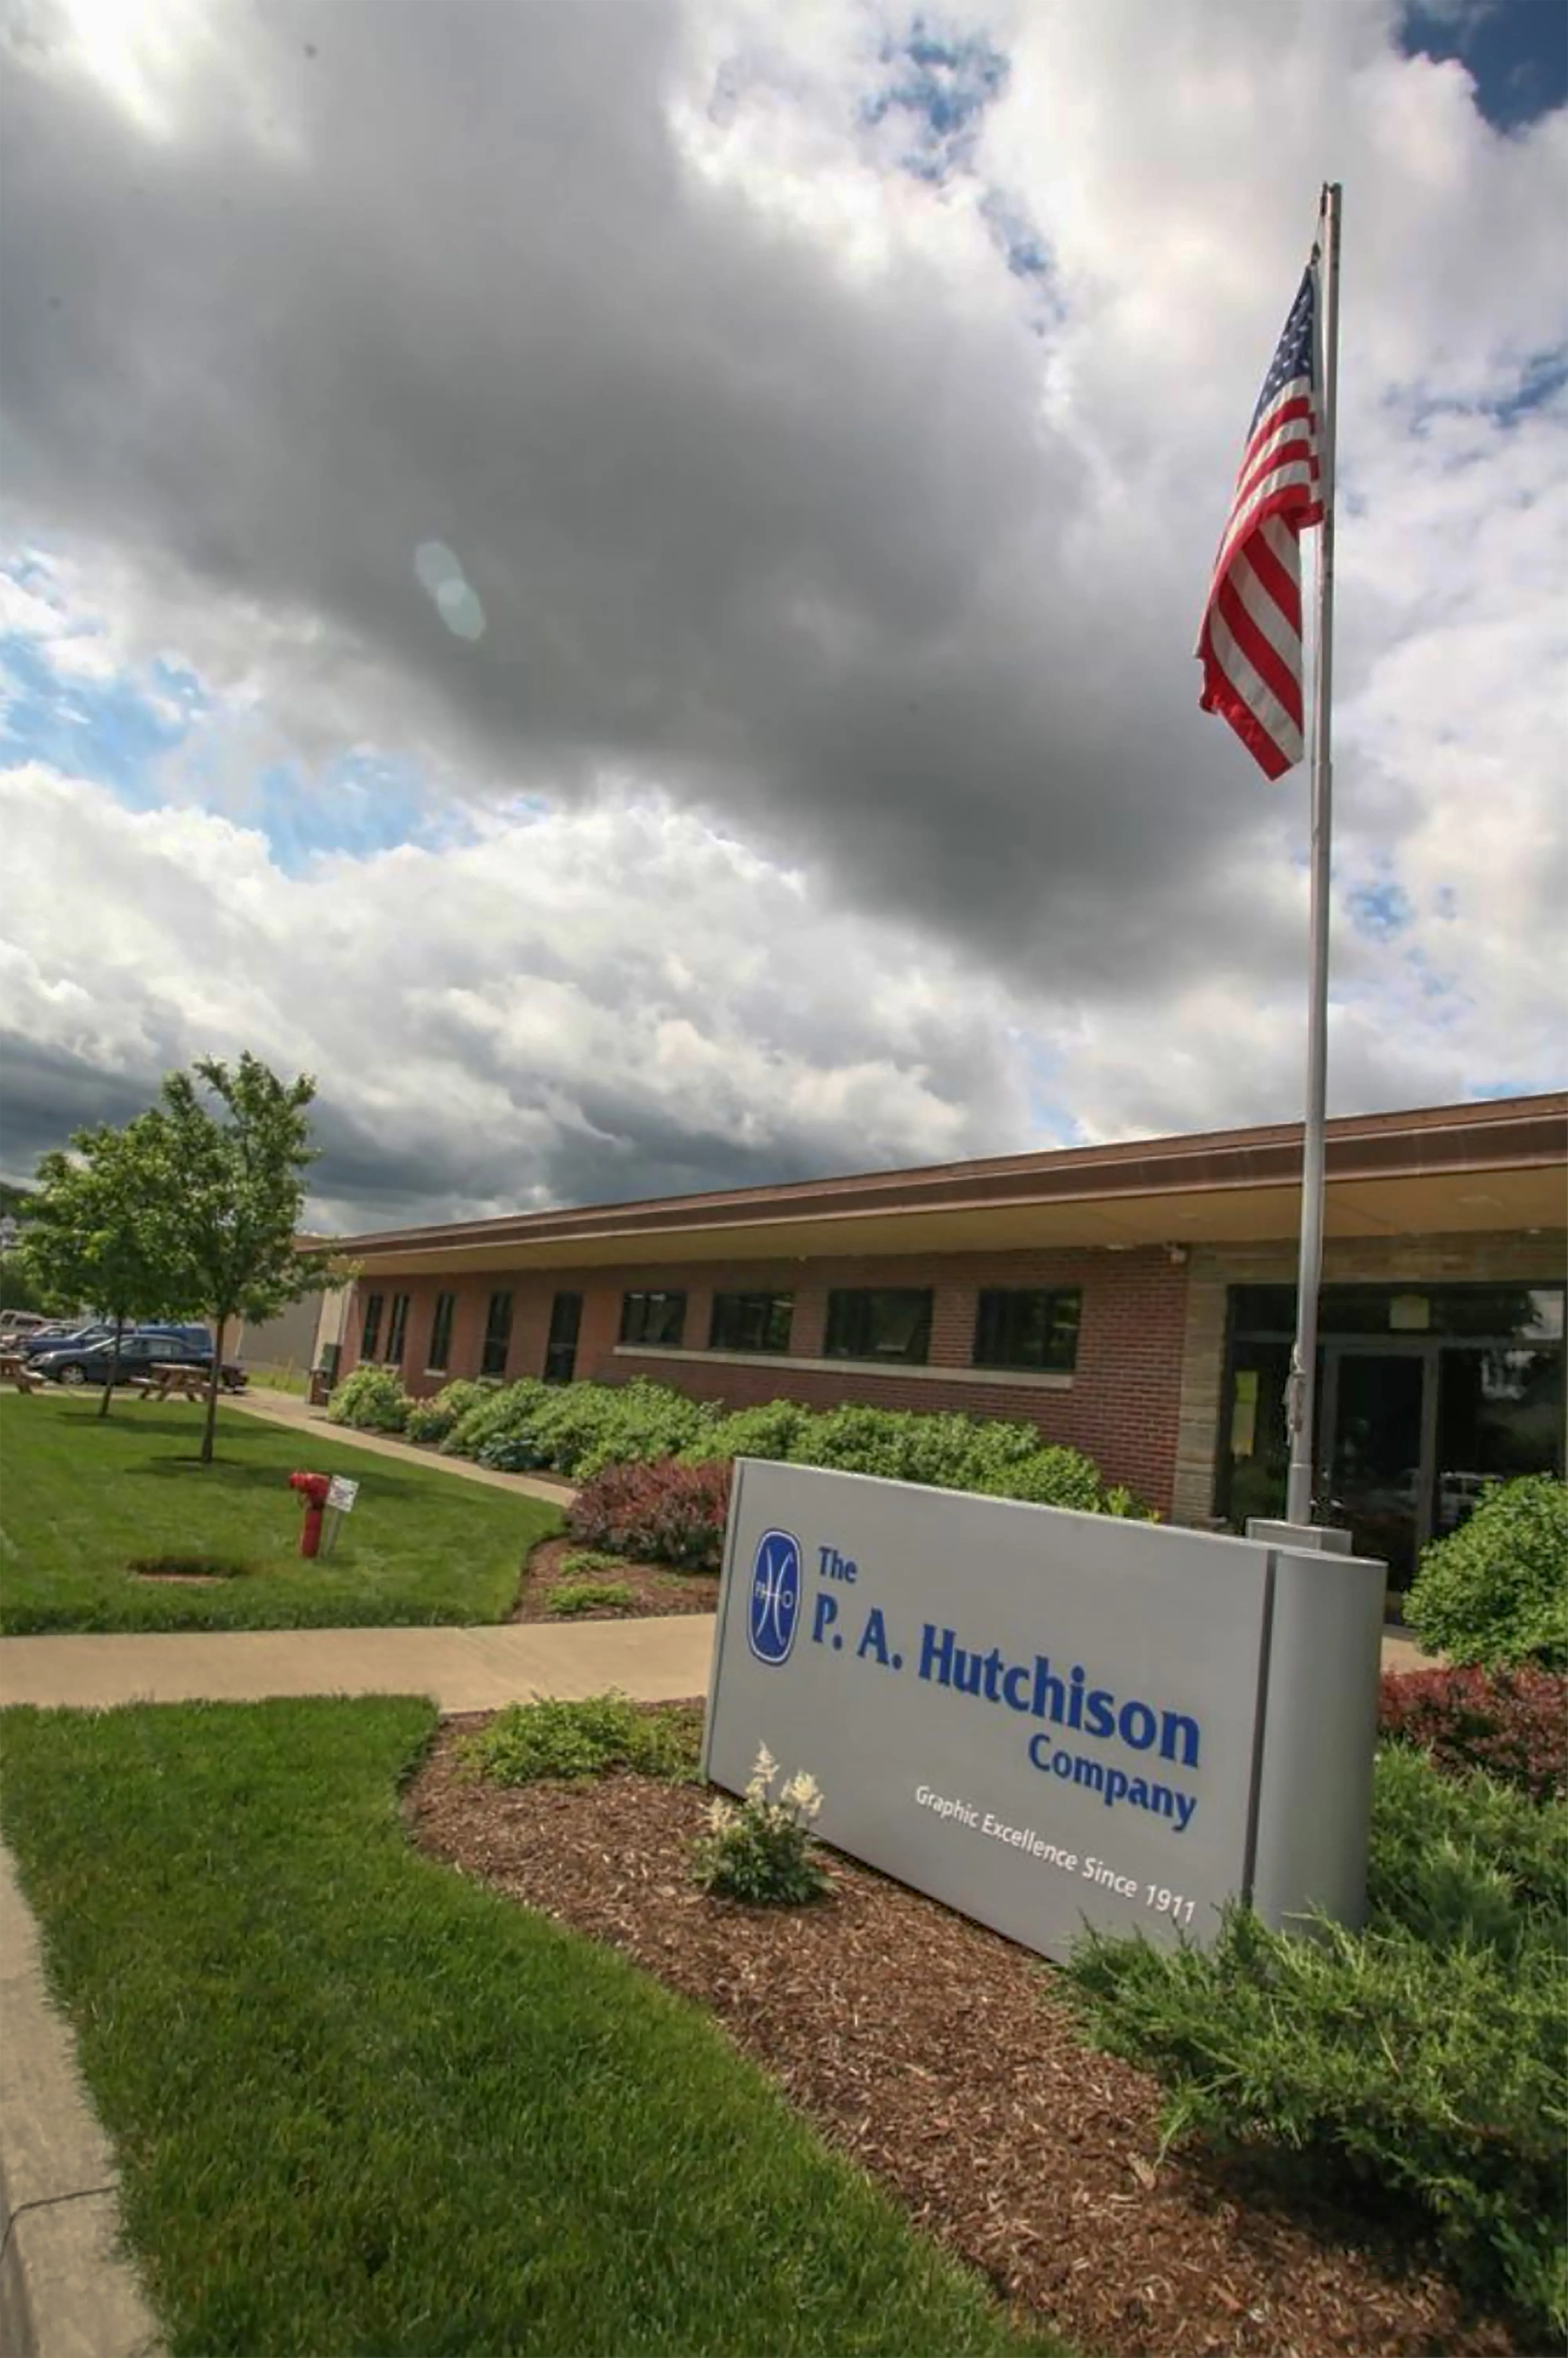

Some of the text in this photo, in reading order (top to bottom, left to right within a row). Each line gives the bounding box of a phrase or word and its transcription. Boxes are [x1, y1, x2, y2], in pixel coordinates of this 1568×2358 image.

[818, 1546, 858, 1584] The
[812, 1592, 1200, 1769] P. A. Hutchison
[1027, 1733, 1198, 1833] Company
[915, 1785, 1196, 1923] Graphic Excellence Since 1911
